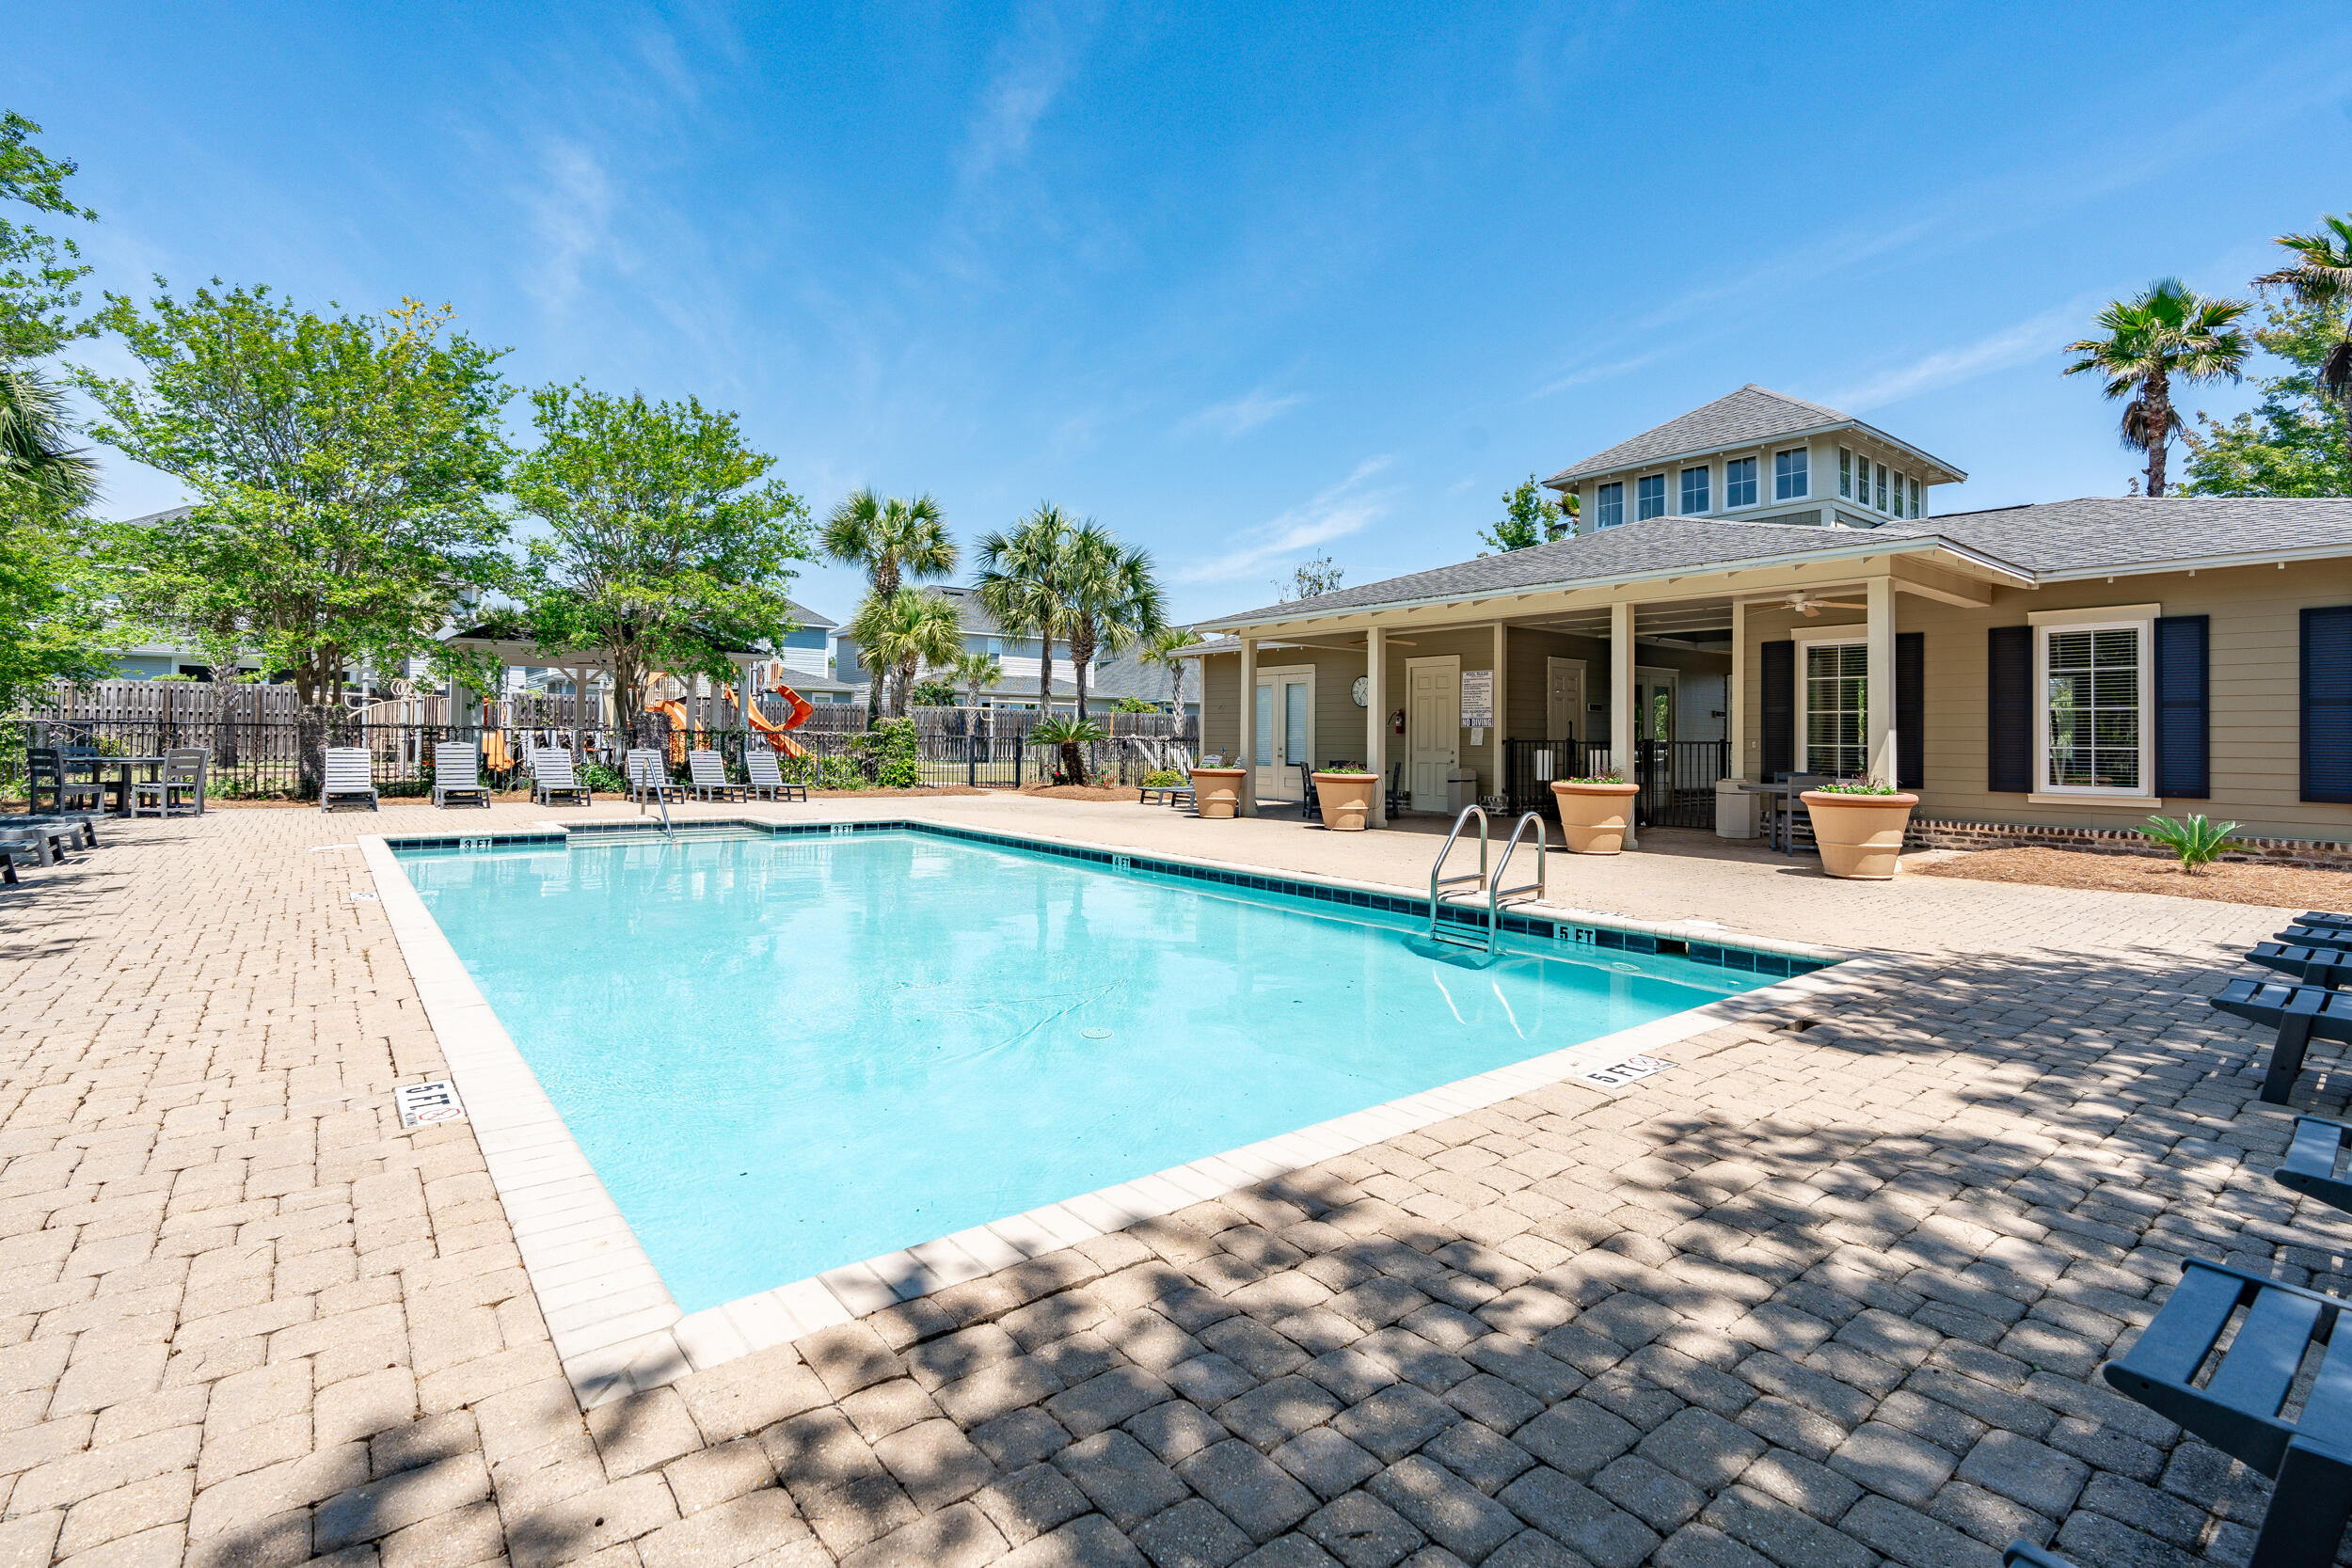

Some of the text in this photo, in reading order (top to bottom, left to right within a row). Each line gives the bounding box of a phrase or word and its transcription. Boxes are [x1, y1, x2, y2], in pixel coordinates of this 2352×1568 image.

[465, 839, 490, 848] 3 FT
[1560, 926, 1593, 942] 5 FT
[1586, 1073, 1618, 1083] 5
[405, 1084, 444, 1093] 5
